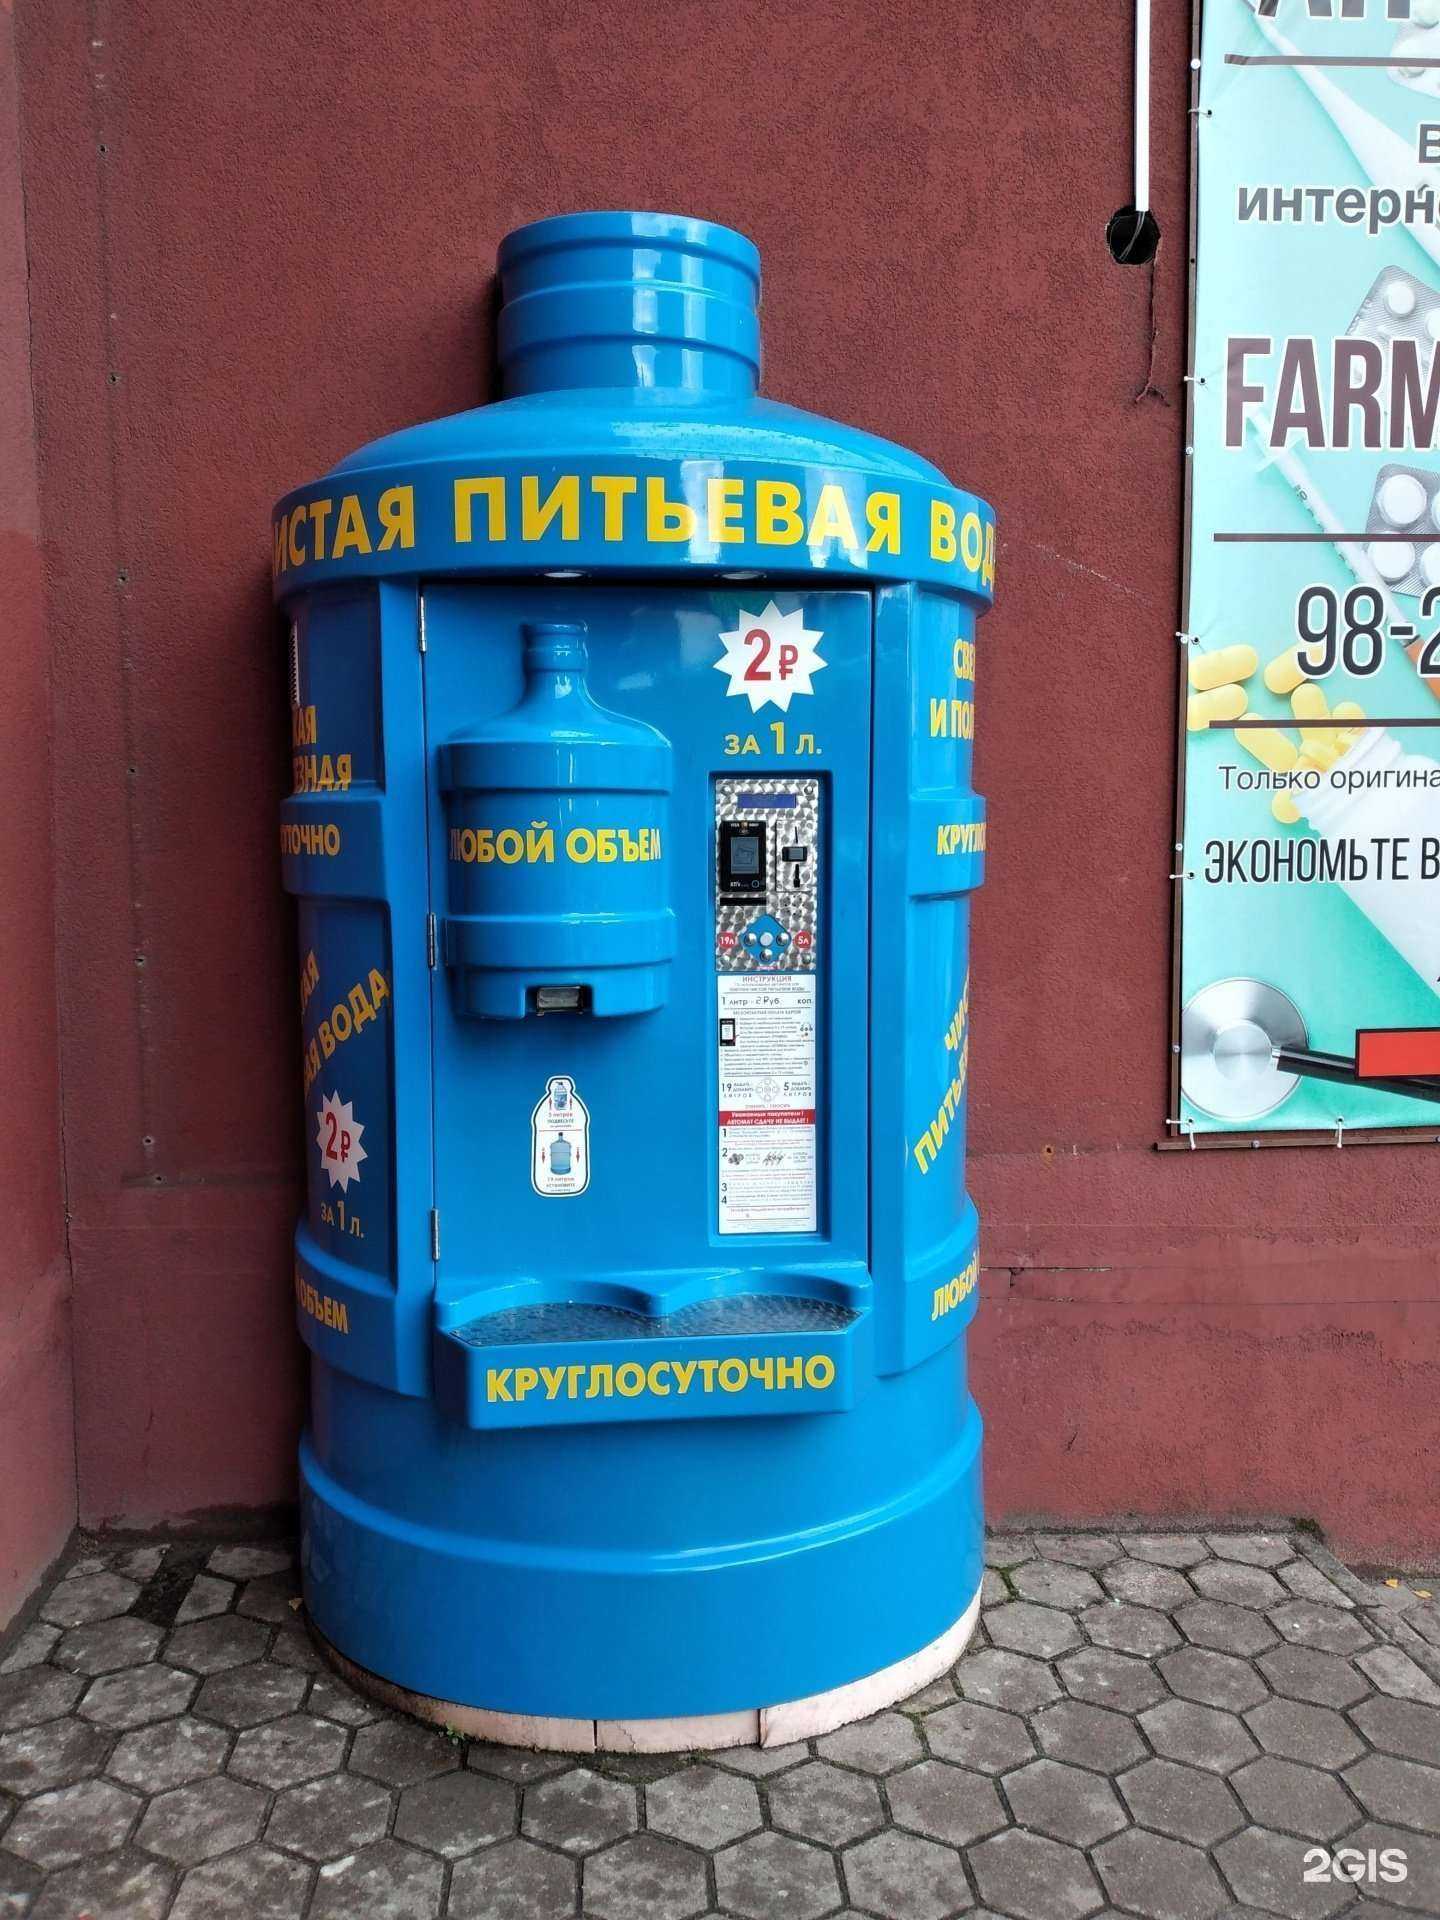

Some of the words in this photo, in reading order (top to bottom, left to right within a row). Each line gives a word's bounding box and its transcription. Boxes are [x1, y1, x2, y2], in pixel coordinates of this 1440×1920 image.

[1238, 187, 1440, 234] интерн
[1226, 338, 1440, 448] FARM
[454, 475, 900, 555] ПИТЬЕВАЯ
[1297, 586, 1440, 676] 98-2
[724, 734, 761, 755] ЗА
[770, 722, 785, 755] 1
[930, 698, 947, 738] И
[1219, 766, 1321, 790] Только
[1331, 769, 1440, 794] оригина
[450, 820, 555, 864] ЛЮБОЙ
[566, 828, 661, 864] ОБЪЕМ
[1204, 837, 1410, 883] ЭКОНОМЬТЕ
[318, 967, 390, 1060] ВОДА
[320, 1201, 335, 1227] ЗА
[337, 1200, 345, 1231] 1
[487, 1355, 835, 1403] КРУГЛОСУТОЧНО
